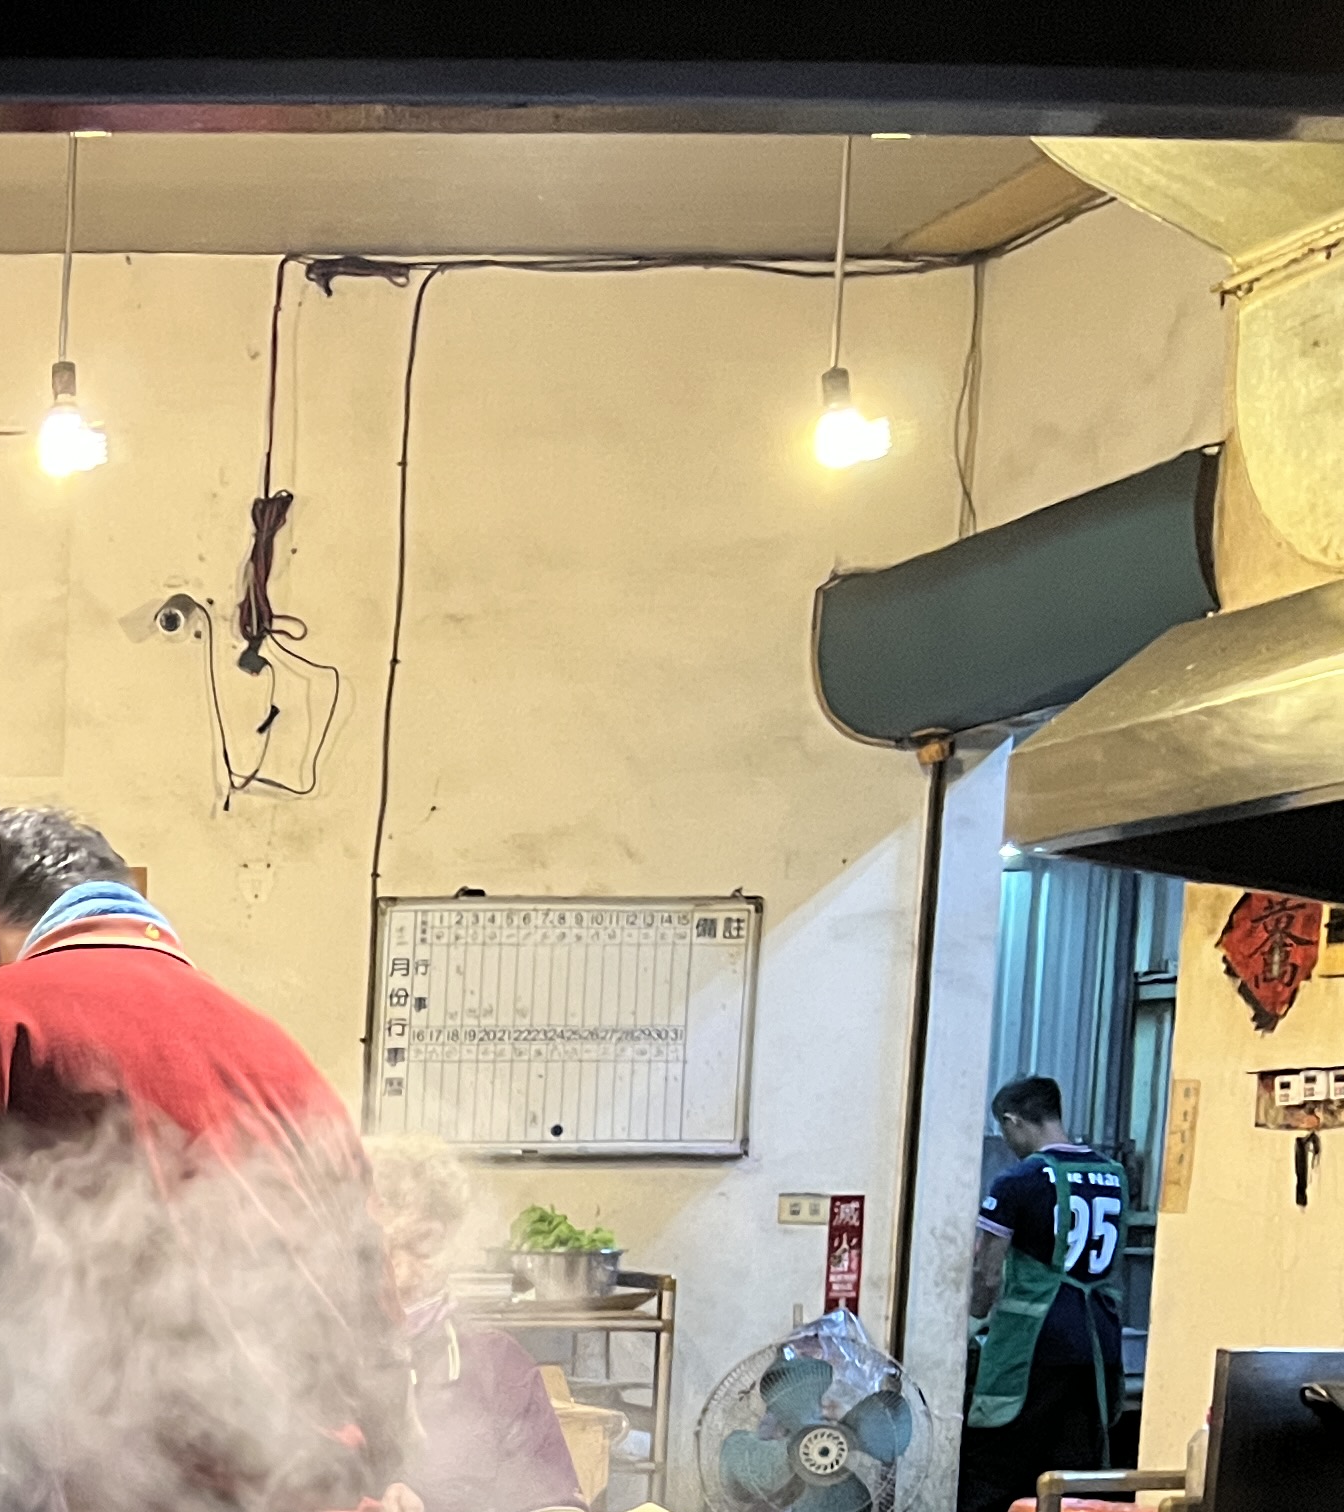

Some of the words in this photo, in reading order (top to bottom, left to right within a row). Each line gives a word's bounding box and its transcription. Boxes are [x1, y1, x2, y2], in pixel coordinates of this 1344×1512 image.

[455, 912, 464, 926] 2
[471, 912, 480, 926] 3
[487, 912, 496, 926] 4
[522, 912, 532, 926] 6
[558, 912, 567, 926] 8
[590, 912, 604, 926] 10
[626, 912, 638, 926] 12
[412, 1028, 424, 1042] 16
[429, 1028, 442, 1042] 17
[447, 1028, 459, 1042] 18
[464, 1028, 476, 1042] 19
[478, 1028, 496, 1042] 20
[497, 1028, 511, 1042] 21
